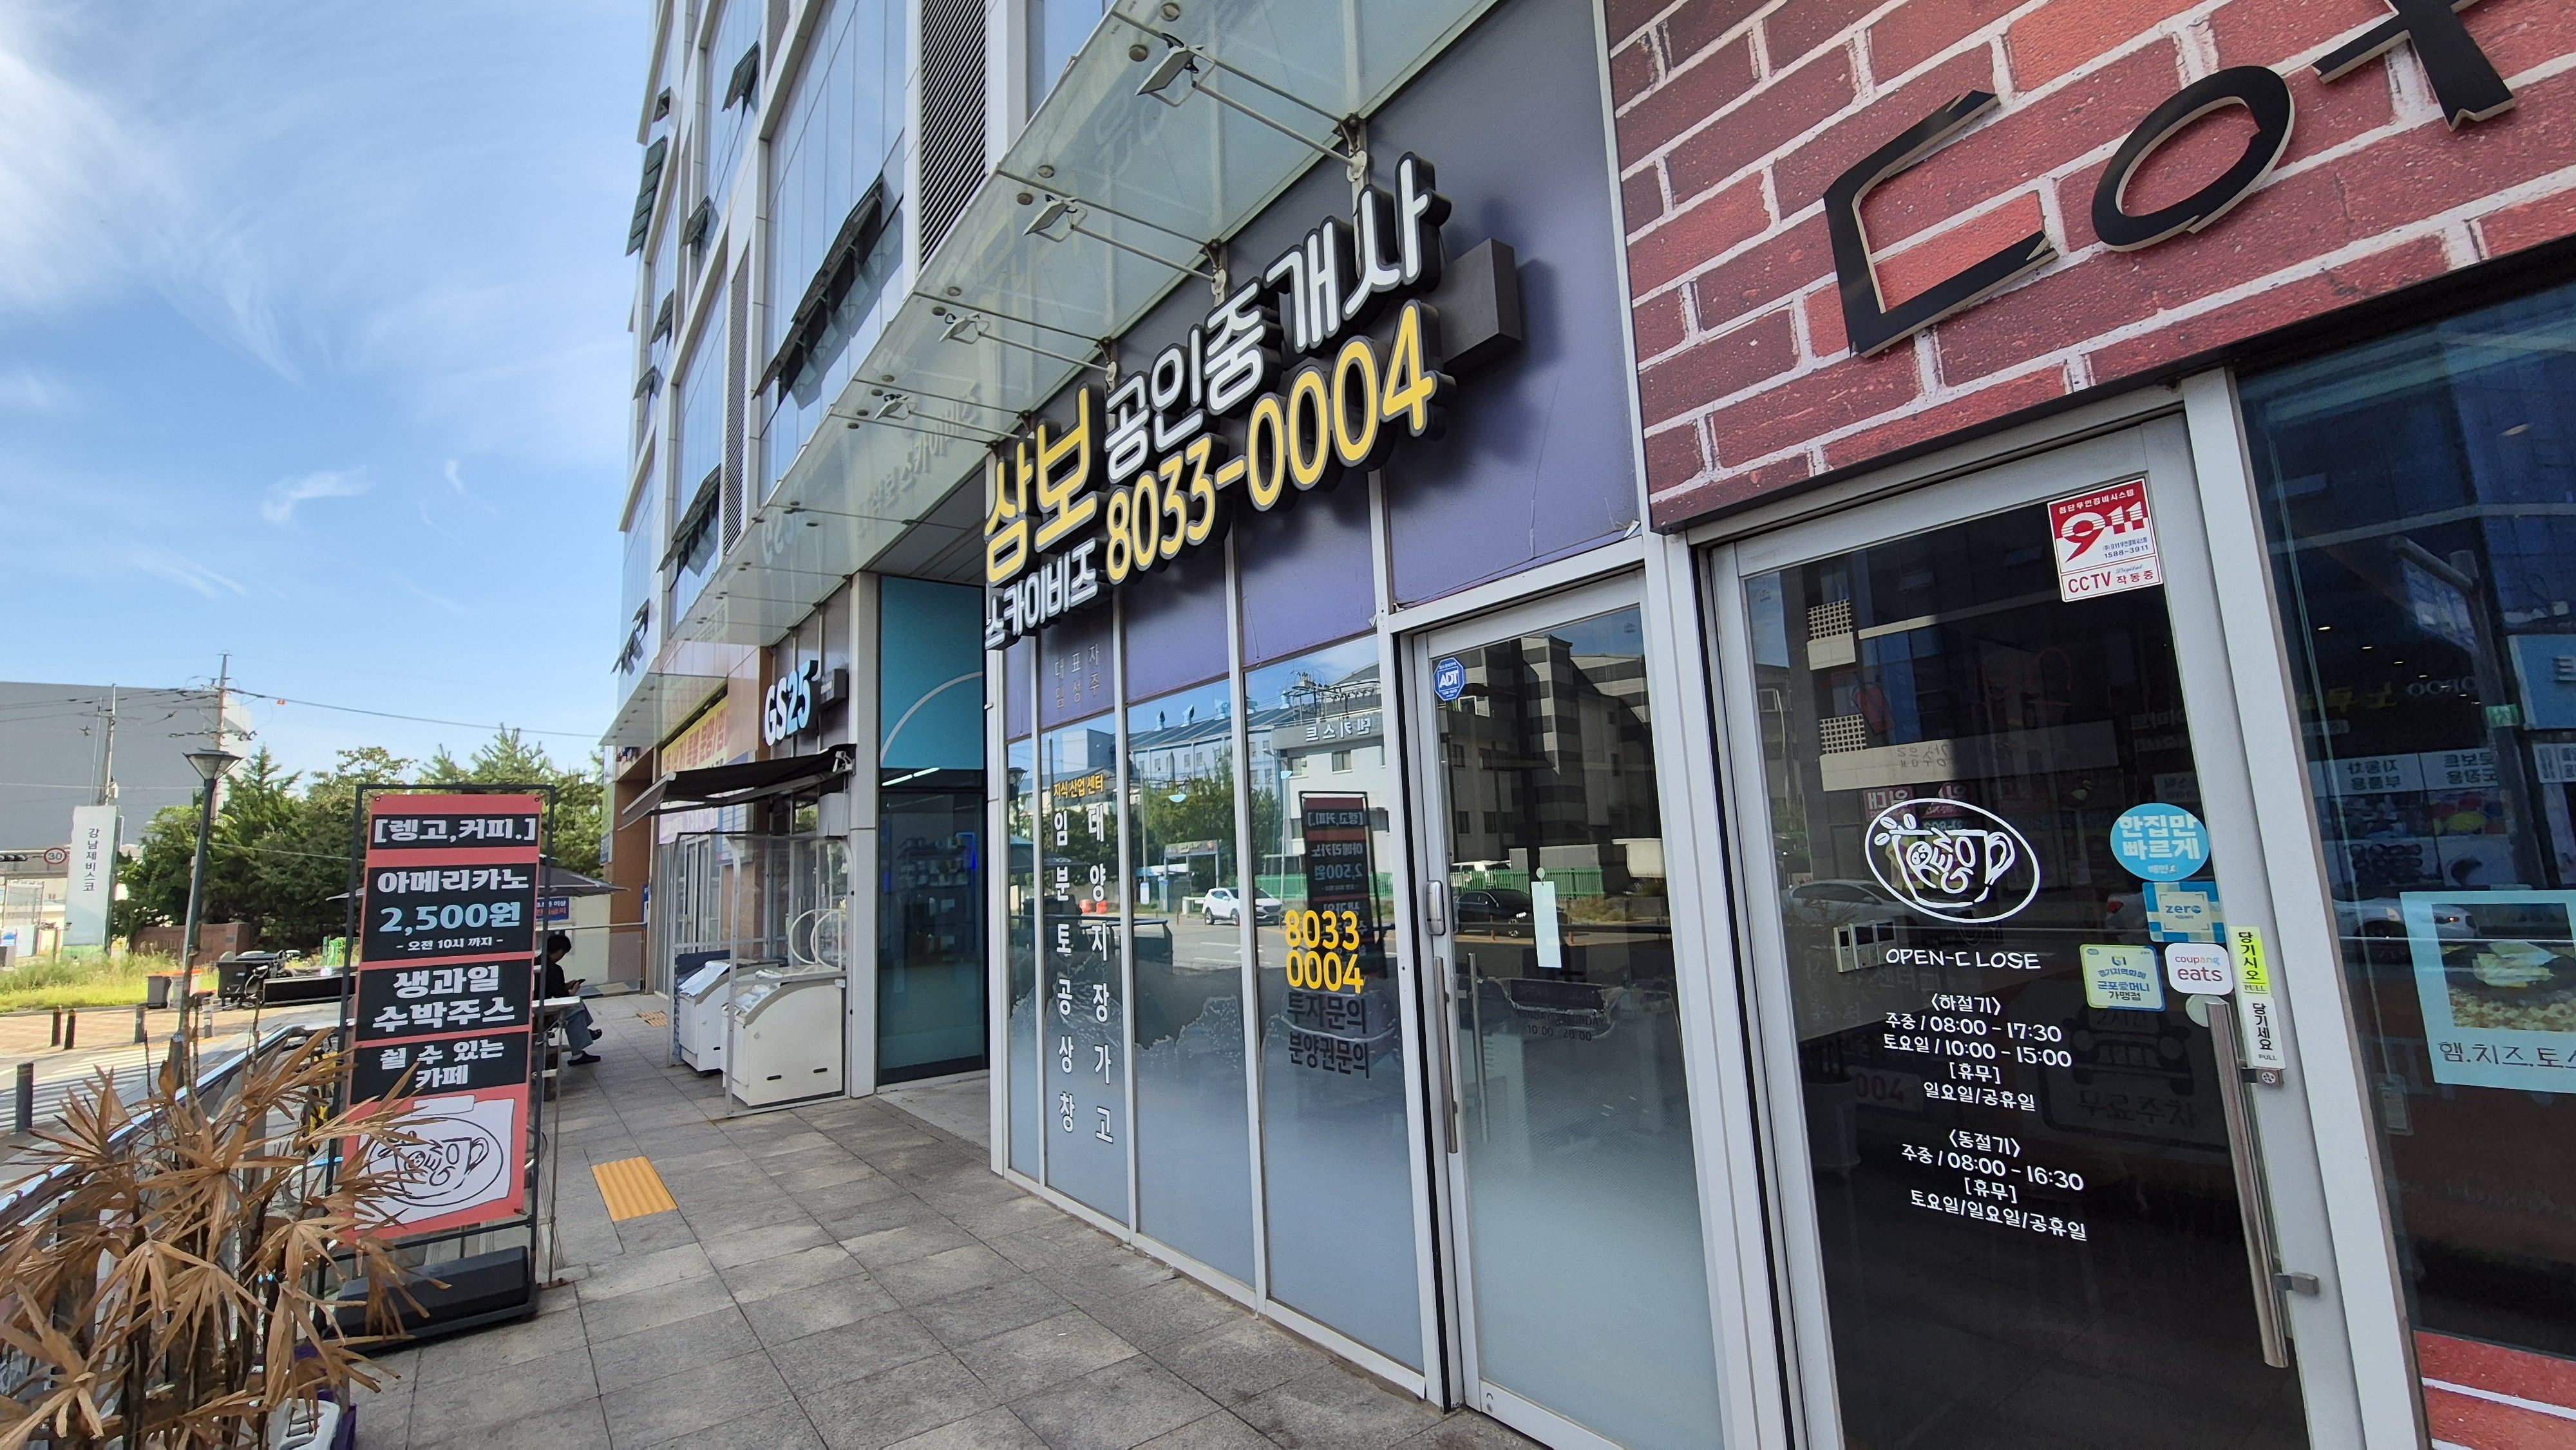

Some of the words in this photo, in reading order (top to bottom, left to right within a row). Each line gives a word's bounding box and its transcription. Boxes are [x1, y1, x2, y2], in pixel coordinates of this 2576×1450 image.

[984, 386, 1096, 585] 삼보
[1103, 155, 1431, 484] 공인중개사
[985, 538, 1097, 649] 스카이비즈
[1106, 304, 1435, 583] 8033-0004
[2061, 500, 2145, 563] 911
[2104, 545, 2149, 559] 1588-3911
[2068, 570, 2111, 593] CCTV
[2116, 569, 2155, 585] 작동중
[1054, 643, 1099, 679] 대표자
[1439, 670, 1459, 688] ADT
[764, 659, 811, 747] GS25
[1053, 780, 1068, 800] 지식
[1069, 777, 1086, 798] 산업
[1086, 773, 1104, 795] 센터
[1054, 804, 1105, 846] 임대
[2118, 813, 2198, 838] 한집만
[47, 852, 62, 861] 30
[82, 828, 100, 892] 강남제비스코
[2122, 838, 2201, 861] 빠르게
[377, 869, 529, 894] 아메리카노
[1054, 863, 1107, 902] 분양
[379, 901, 520, 936] 2,500원
[1284, 909, 1360, 951] 8033
[407, 938, 433, 952] 오전
[437, 937, 464, 950] 10시
[467, 936, 493, 948] 까지
[1056, 922, 1108, 961] 토지
[2238, 931, 2261, 981] 당기시오
[1285, 949, 1365, 994] 0004
[2175, 955, 2221, 966] coupang
[2177, 966, 2223, 983] eats
[393, 965, 500, 999] 생과일
[2108, 991, 2141, 1001] 가맹점
[2244, 984, 2266, 992] PULL
[372, 997, 515, 1032] 수박주스
[1057, 979, 1110, 1022] 공장
[1287, 992, 1367, 1035] 투자문의
[1885, 1012, 1917, 1030] 주중
[1929, 1015, 1987, 1036] 08:00
[2007, 1022, 2062, 1042] 17:30
[2252, 1003, 2273, 1051] 당기세요
[379, 1047, 407, 1071] 쉴
[417, 1044, 443, 1065] 수
[453, 1039, 505, 1062] 있는
[1058, 1035, 1112, 1085] 상가
[1288, 1031, 1370, 1079] 분양권문의
[1883, 1033, 1930, 1054] 토요일
[1945, 1039, 1996, 1060] 10:00
[2016, 1046, 2072, 1068] 15:00
[415, 1064, 469, 1089] 카페
[1949, 1061, 2002, 1085] [휴무]
[1922, 1081, 2036, 1112] 일요일/공휴일
[1059, 1091, 1114, 1144] 창고
[1901, 1144, 1933, 1165] 주중
[1947, 1152, 2006, 1177] 08:00
[2027, 1165, 2085, 1191] 16:30
[1964, 1177, 2018, 1204] [휴무]
[1910, 1189, 2087, 1241] 토요일/일요일/공휴일
